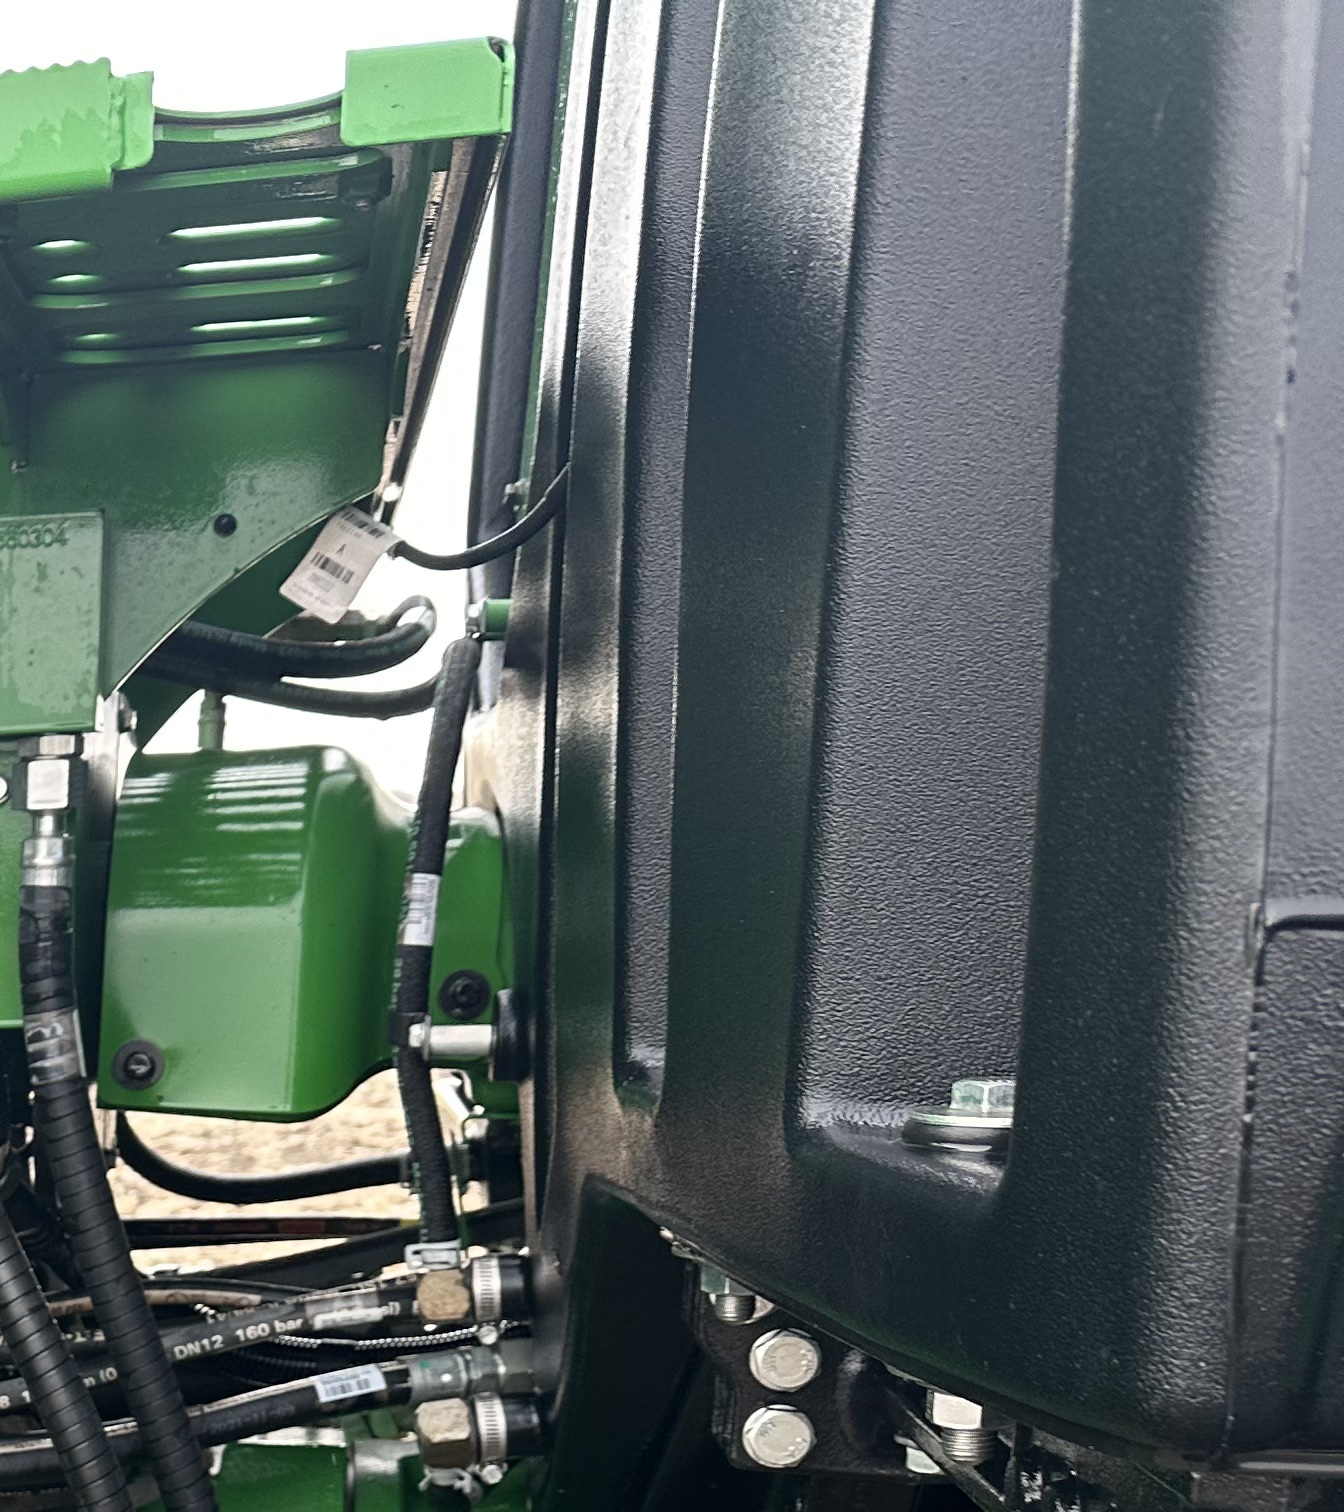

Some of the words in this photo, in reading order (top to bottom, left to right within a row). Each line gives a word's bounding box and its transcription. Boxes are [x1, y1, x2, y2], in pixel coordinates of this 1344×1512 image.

[337, 543, 345, 556] A
[173, 1334, 224, 1362] DN12
[234, 1324, 270, 1345] 160
[274, 1317, 303, 1337] bar
